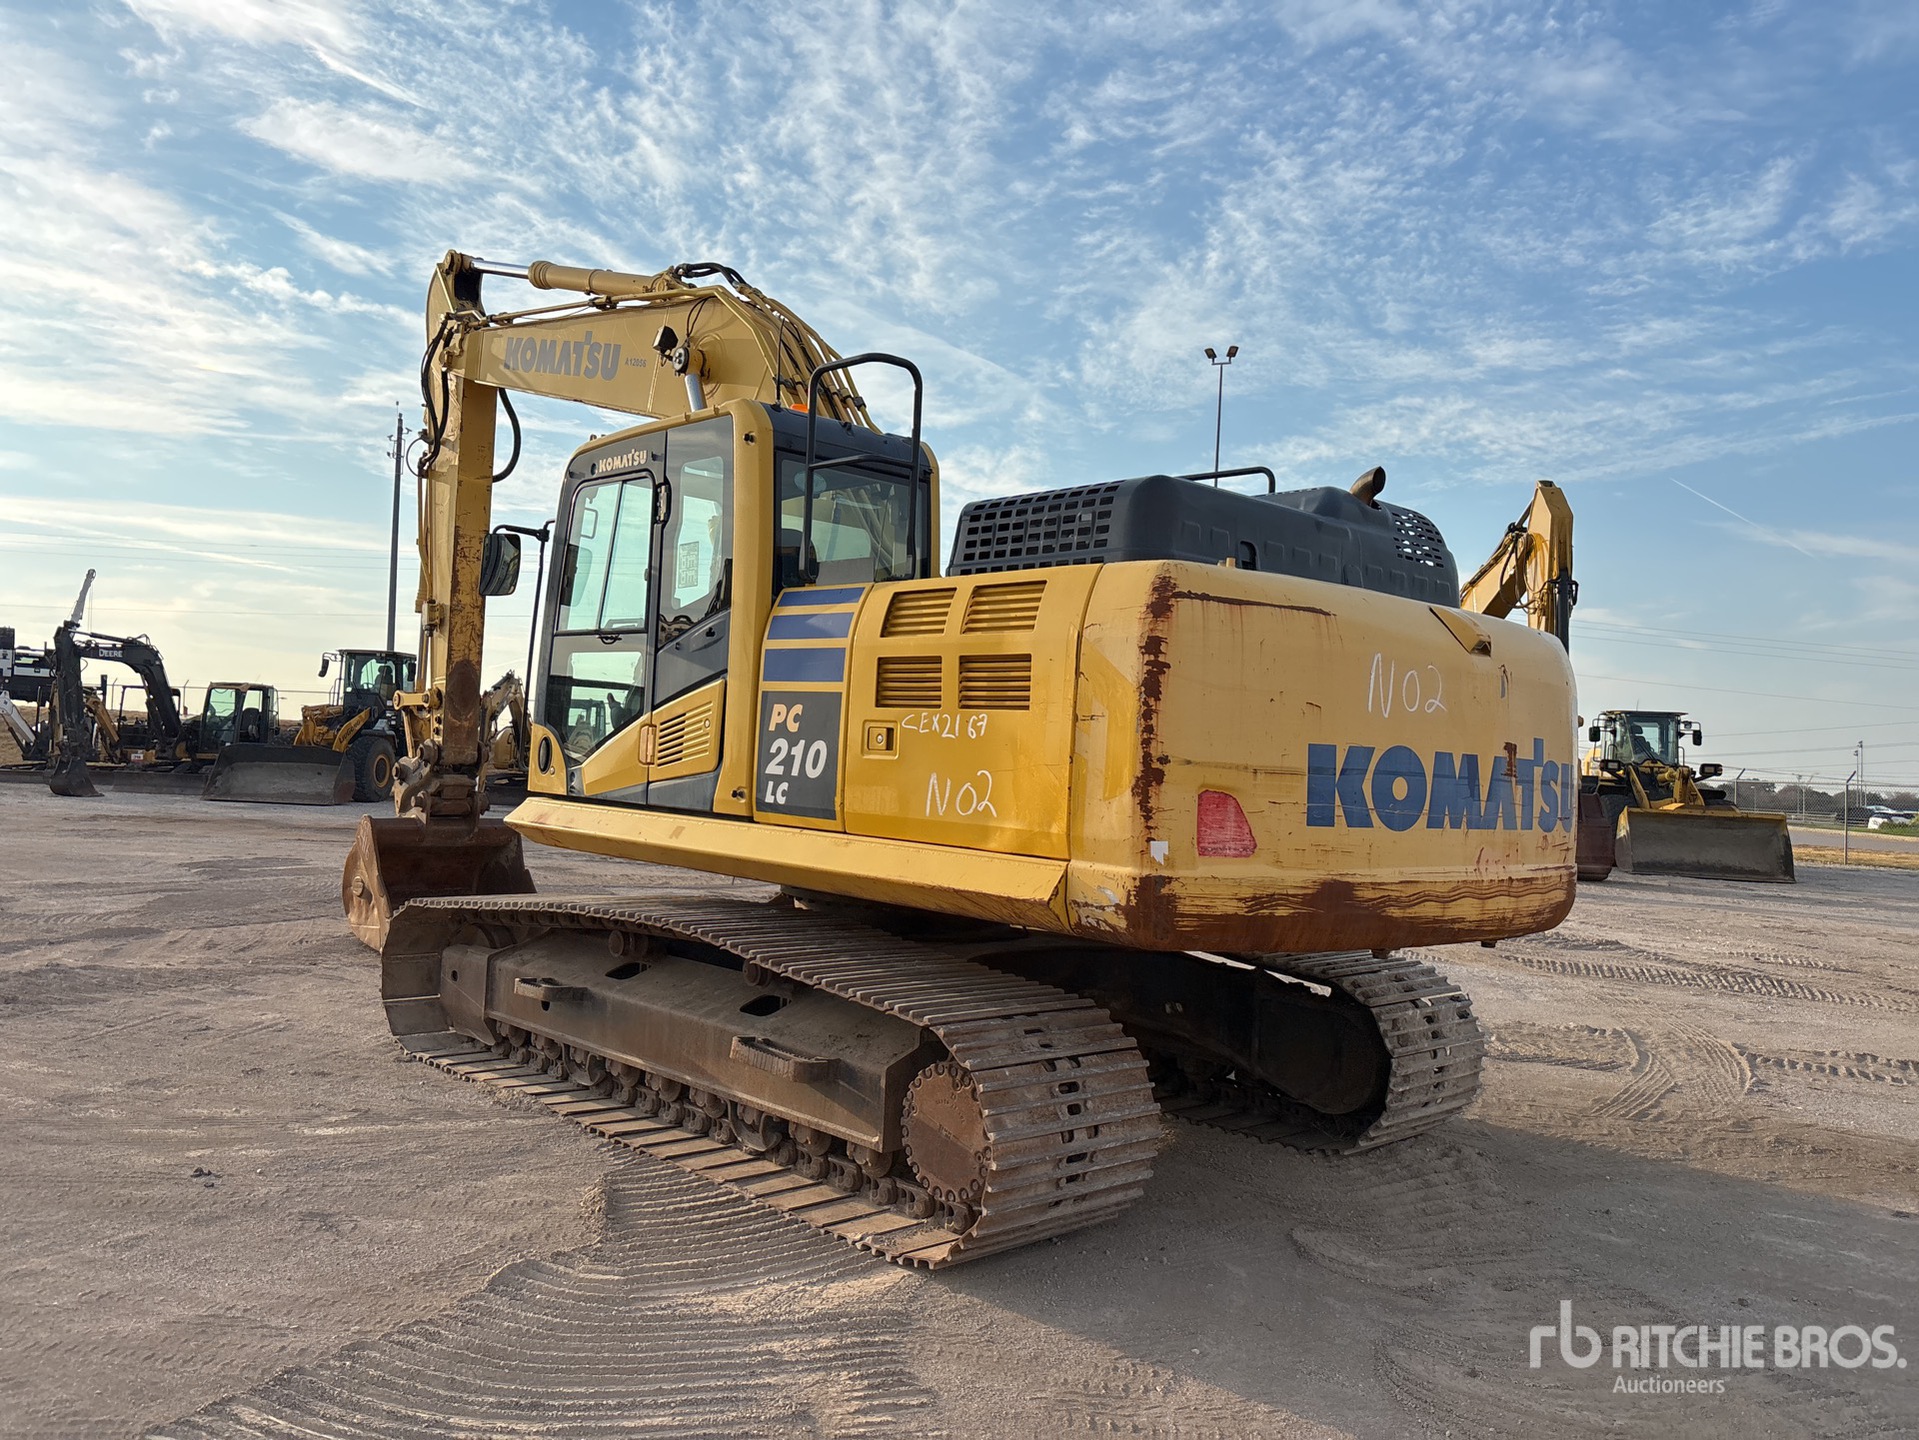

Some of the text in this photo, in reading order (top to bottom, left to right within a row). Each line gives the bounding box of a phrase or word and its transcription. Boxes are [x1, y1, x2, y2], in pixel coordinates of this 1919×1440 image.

[504, 331, 622, 381] KOMATSU
[599, 449, 648, 473] KOMATSU
[99, 649, 124, 658] DEERE
[768, 703, 803, 733] PC
[765, 738, 828, 779] 210
[764, 780, 790, 805] LC
[1306, 738, 1575, 833] KOMATSU
